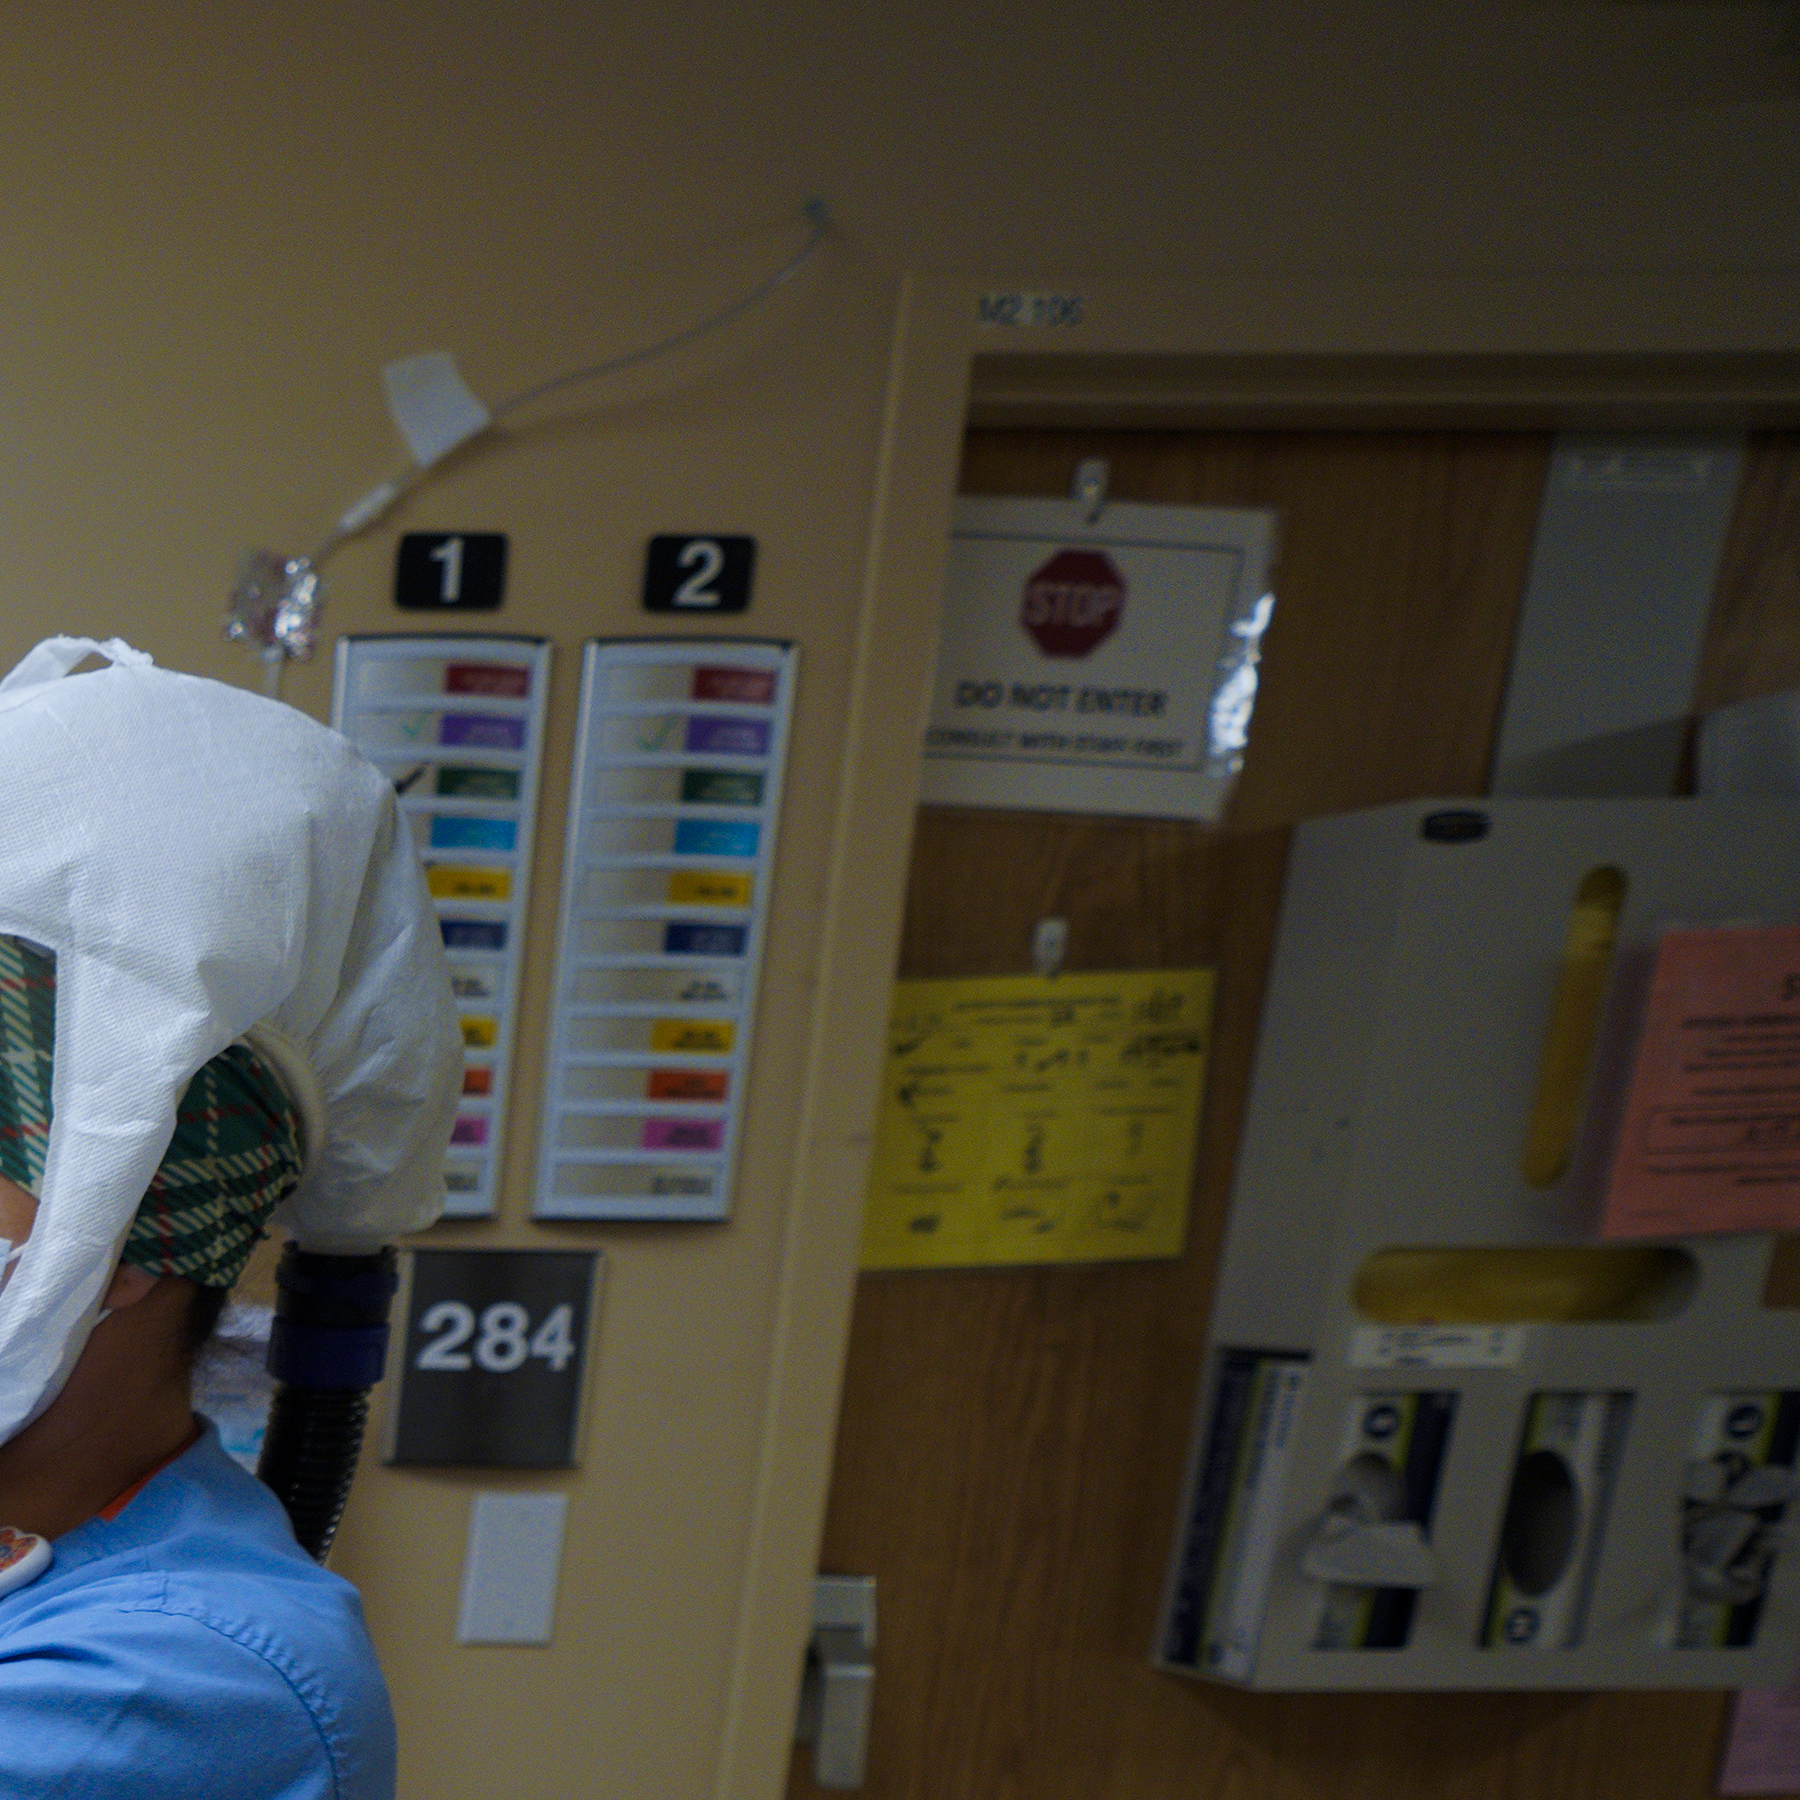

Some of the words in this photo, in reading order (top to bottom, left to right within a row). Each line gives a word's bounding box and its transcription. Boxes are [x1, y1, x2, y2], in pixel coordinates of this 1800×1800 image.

[429, 537, 466, 602] 1
[673, 541, 725, 608] 2
[1024, 581, 1123, 627] STOP
[956, 680, 1003, 708] DO
[1010, 682, 1071, 712] NOT
[1077, 686, 1167, 717] ENTER
[415, 1300, 577, 1372] 284
